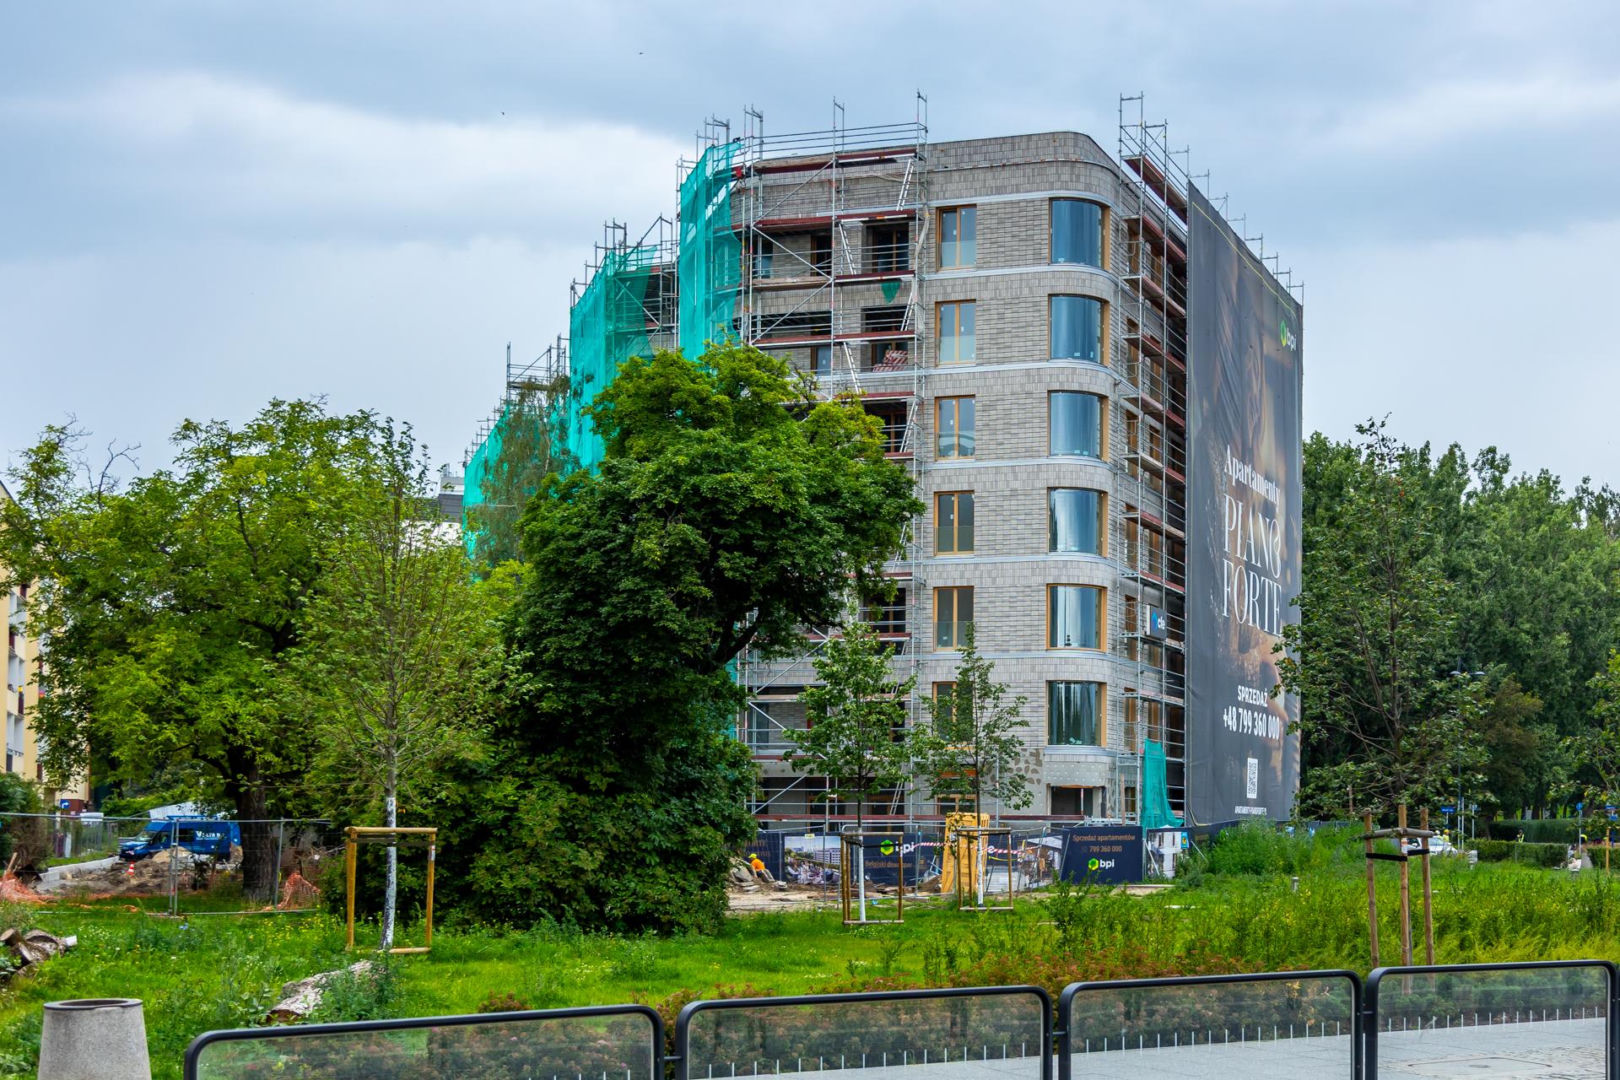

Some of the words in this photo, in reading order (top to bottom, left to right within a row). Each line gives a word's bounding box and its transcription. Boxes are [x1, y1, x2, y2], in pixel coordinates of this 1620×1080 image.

[1287, 327, 1297, 351] bpi
[1224, 444, 1281, 513] Apartamenty
[1223, 493, 1281, 579] PIANO
[1222, 558, 1282, 637] FORTE
[1237, 685, 1268, 707] SPRZEDAŻ
[1223, 705, 1237, 732] +48
[1238, 707, 1252, 735] 799
[1254, 711, 1266, 737] 360
[1268, 715, 1279, 740] 000
[1099, 858, 1115, 870] bpi
